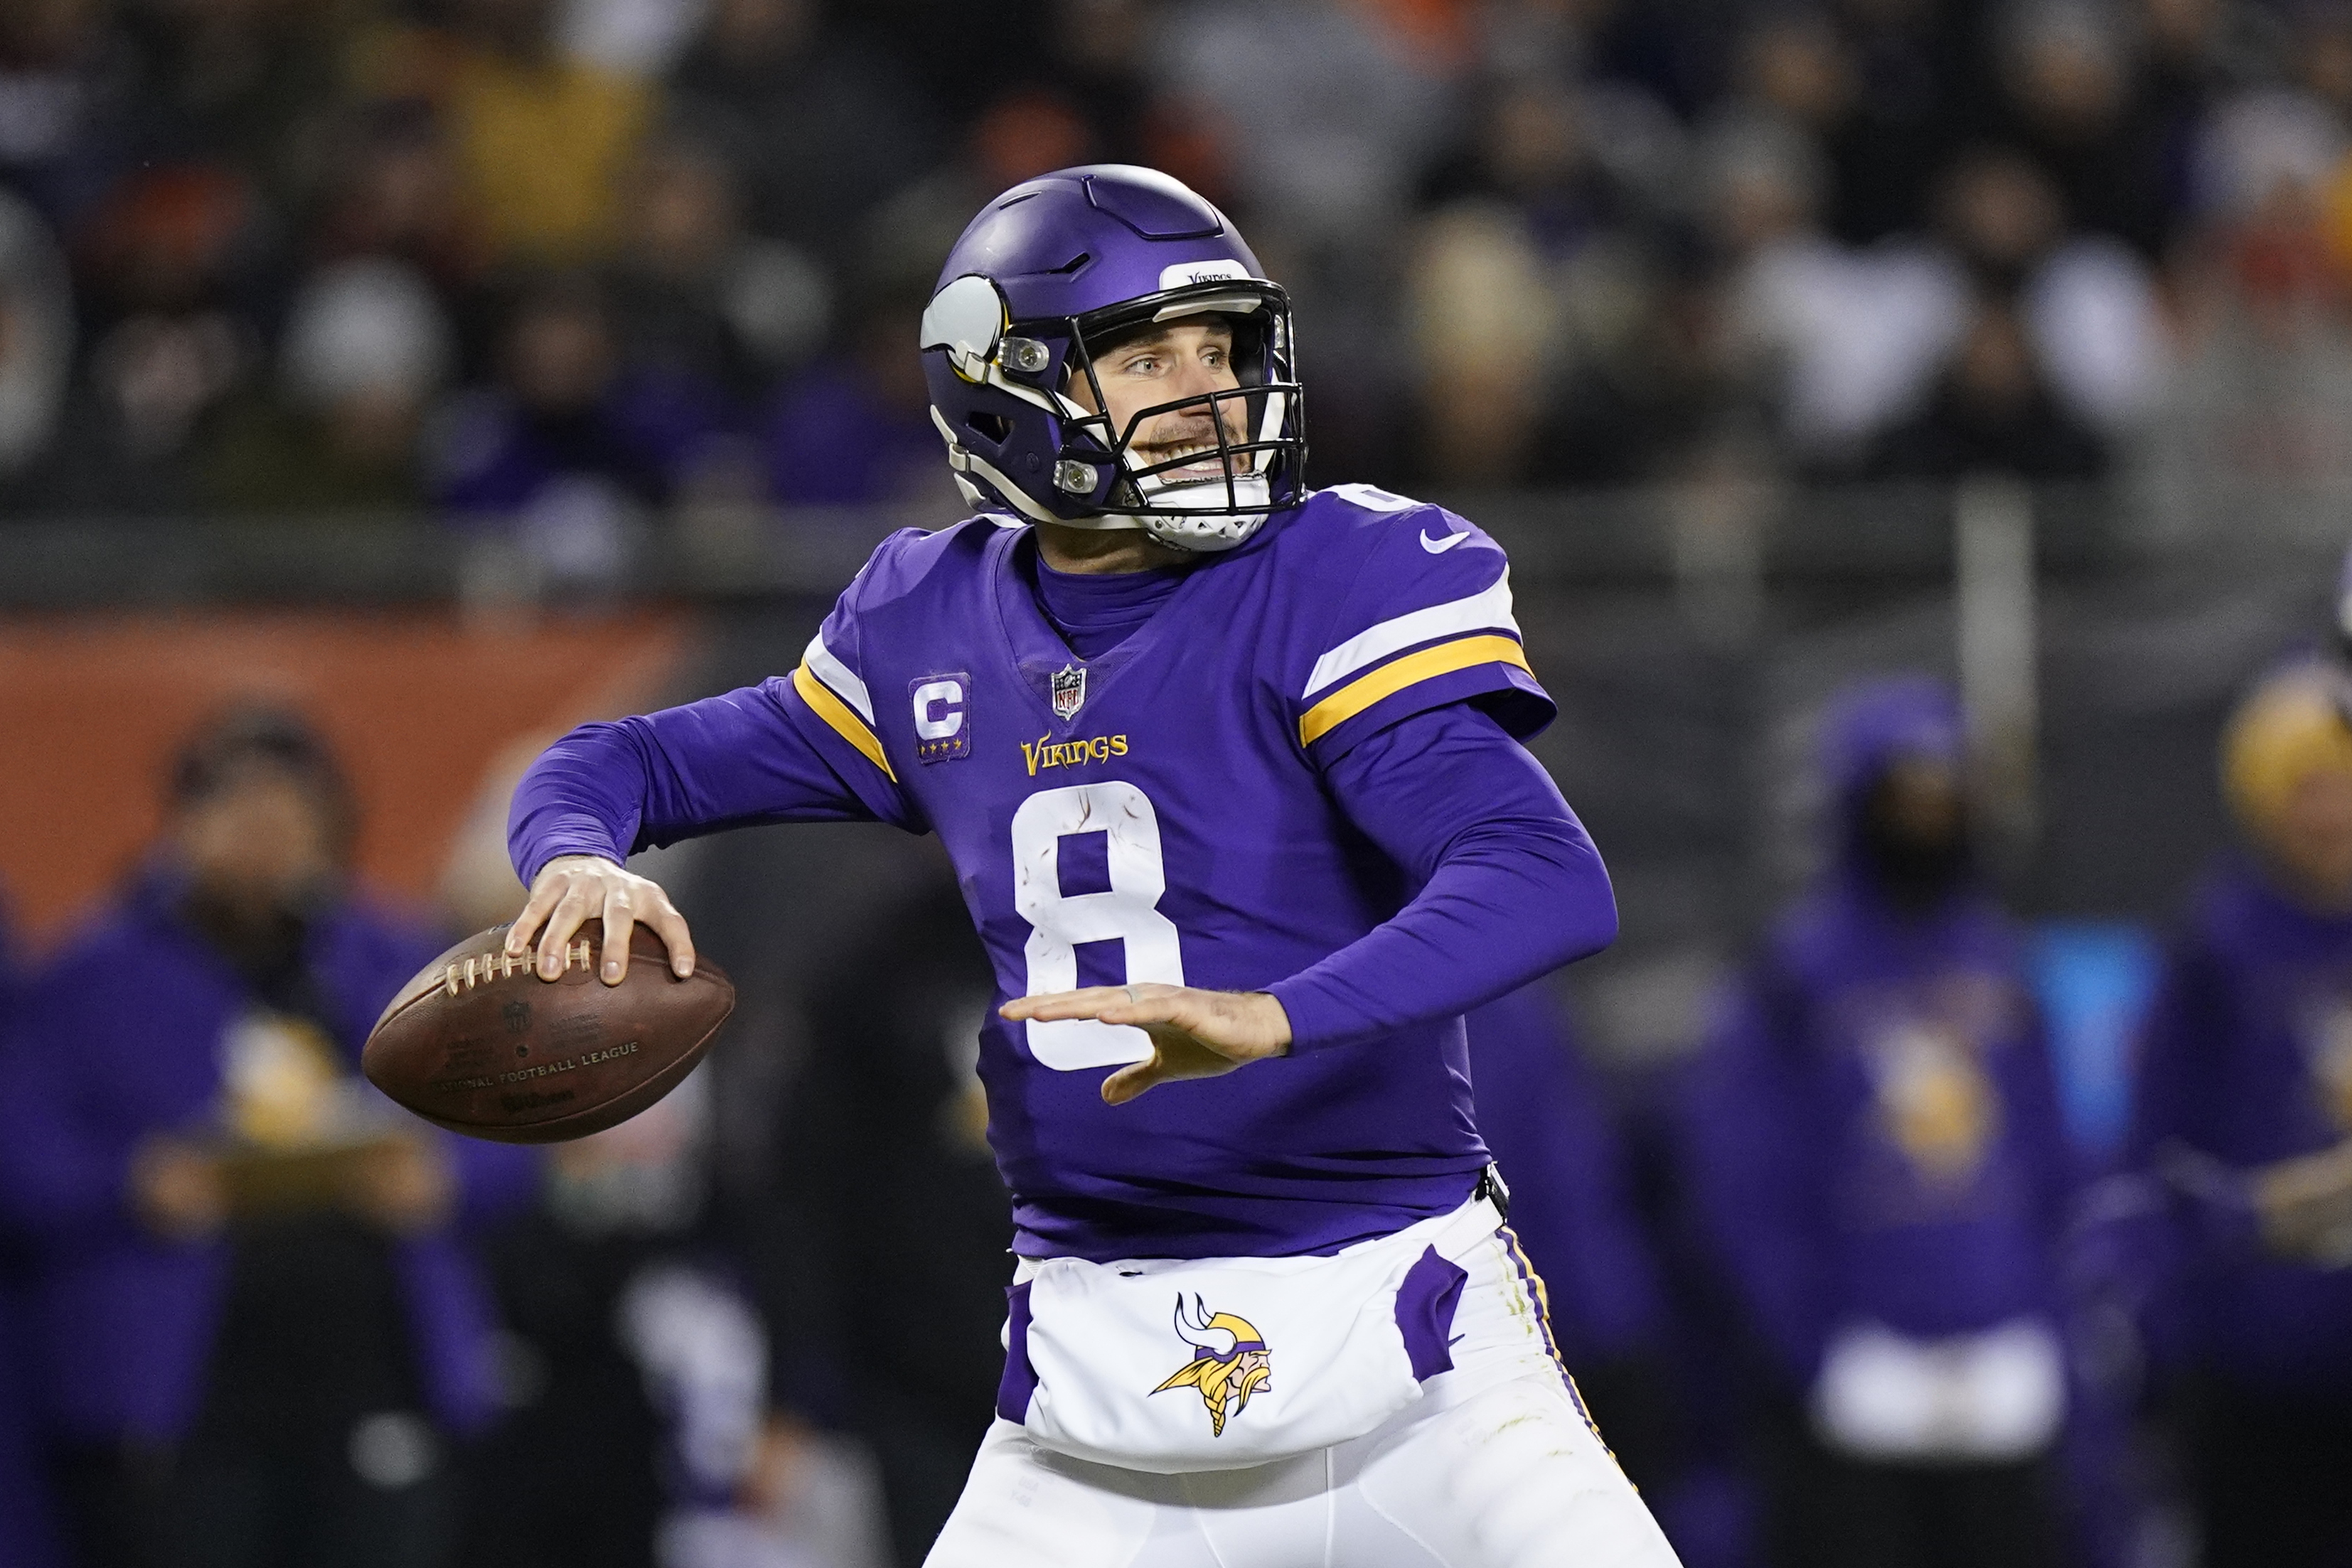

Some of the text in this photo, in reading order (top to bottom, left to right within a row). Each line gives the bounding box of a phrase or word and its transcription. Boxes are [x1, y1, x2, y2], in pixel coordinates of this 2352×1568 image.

[913, 680, 963, 741] C
[1058, 689, 1079, 709] NFL
[1011, 780, 1185, 1071] 8
[500, 1059, 576, 1084] FOOTBALL
[581, 1041, 639, 1066] LEAGUE
